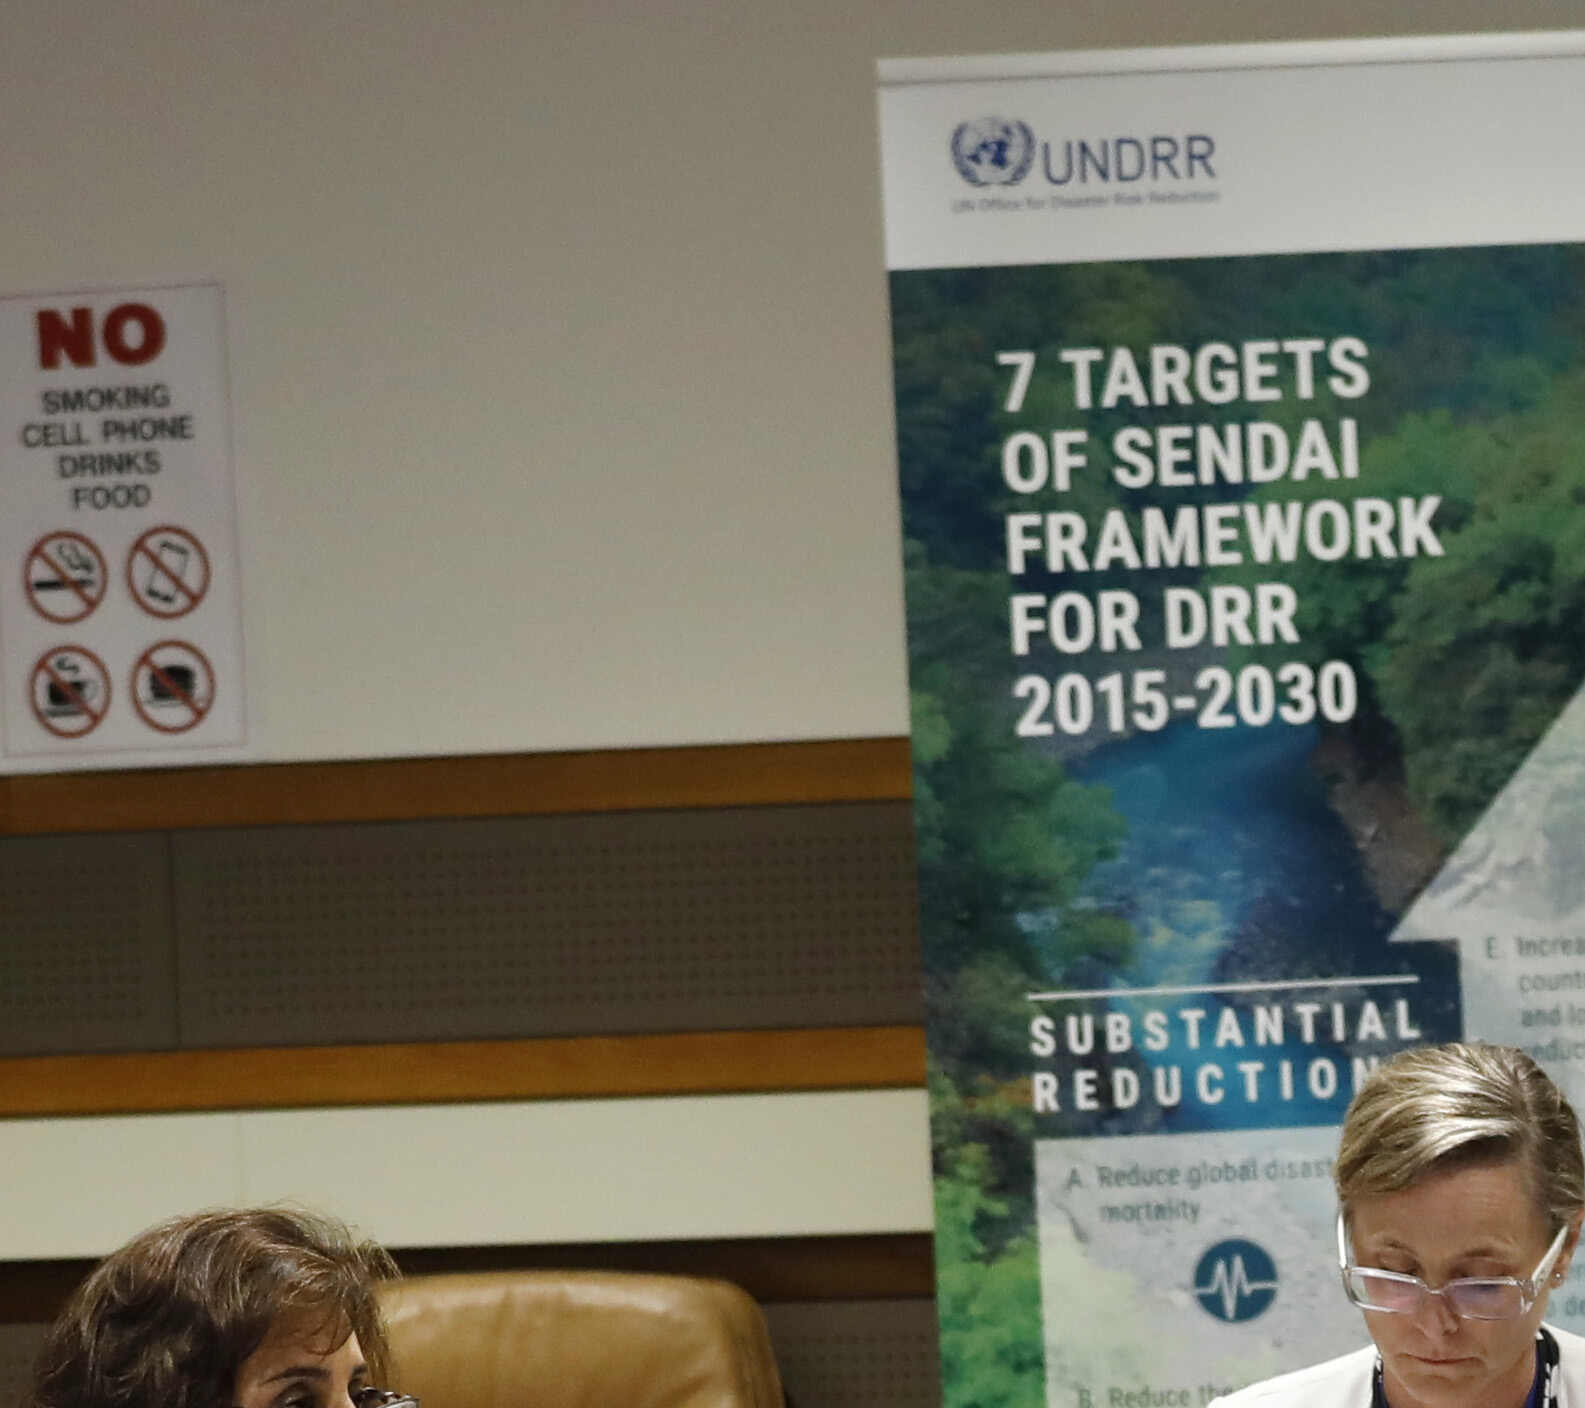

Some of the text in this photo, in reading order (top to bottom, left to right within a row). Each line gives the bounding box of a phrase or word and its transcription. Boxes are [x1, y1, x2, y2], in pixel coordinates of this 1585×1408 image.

[1042, 134, 1217, 186] UNDRR
[36, 303, 167, 370] NO
[41, 385, 171, 415] SMOKING
[995, 336, 1371, 413] 7 TARGETS
[22, 415, 195, 448] CELL PHONE
[1001, 418, 1360, 494] OF SENDAI
[58, 450, 162, 479] DRINKS
[72, 484, 153, 511] FOOD
[1006, 495, 1445, 576] FRAMEWORK
[1010, 582, 1301, 657] FOR DRR
[1013, 660, 1358, 738] 2015-2030
[1028, 1000, 1422, 1057] SUBSTANTIAL
[1520, 1003, 1562, 1028] and
[1097, 1161, 1181, 1189] Reduce
[1189, 1156, 1260, 1191] global
[1101, 1200, 1202, 1226] mortality
